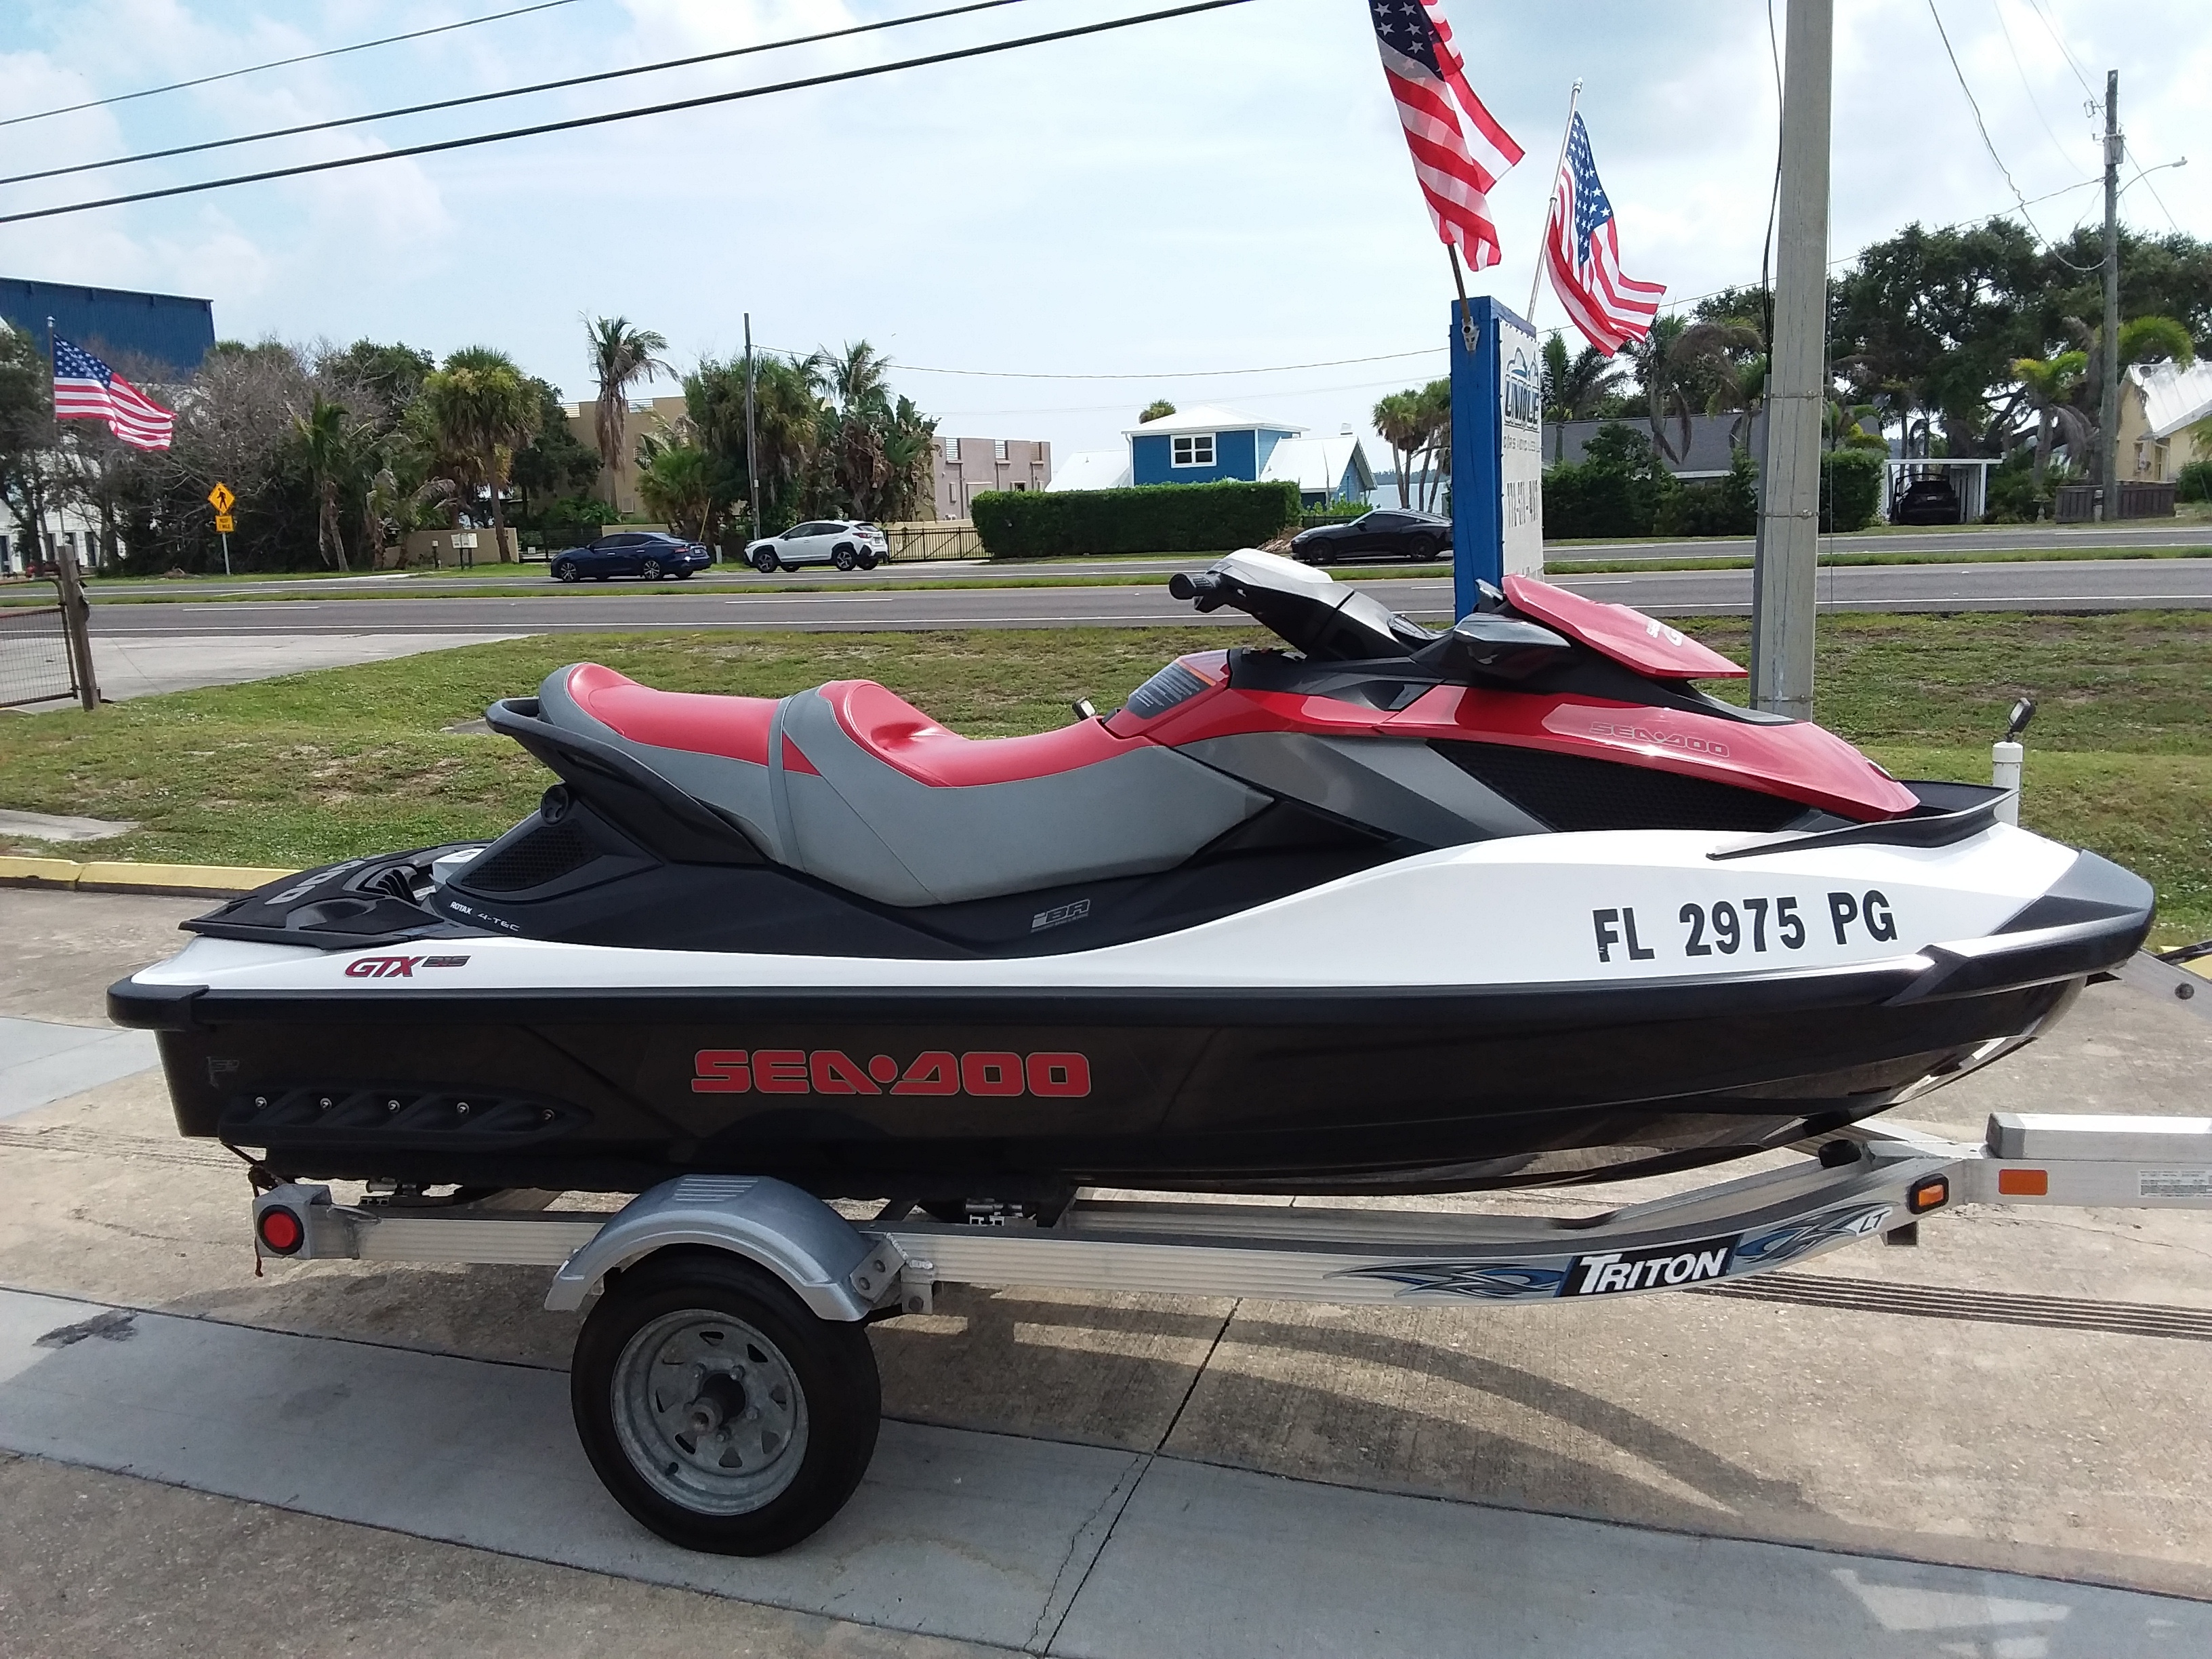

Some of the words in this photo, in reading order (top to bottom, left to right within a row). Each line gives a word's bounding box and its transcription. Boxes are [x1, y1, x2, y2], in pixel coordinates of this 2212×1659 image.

[1504, 377, 1540, 427] UNIQUE
[449, 901, 473, 915] ROTAX
[477, 913, 520, 932] 4-TEC
[1593, 907, 1656, 963] FL
[1679, 897, 1807, 957] 2975
[1827, 889, 1898, 945] PG
[345, 956, 428, 977] GTX
[1858, 1210, 1891, 1233] LT
[1578, 1247, 1728, 1295] TRITON
